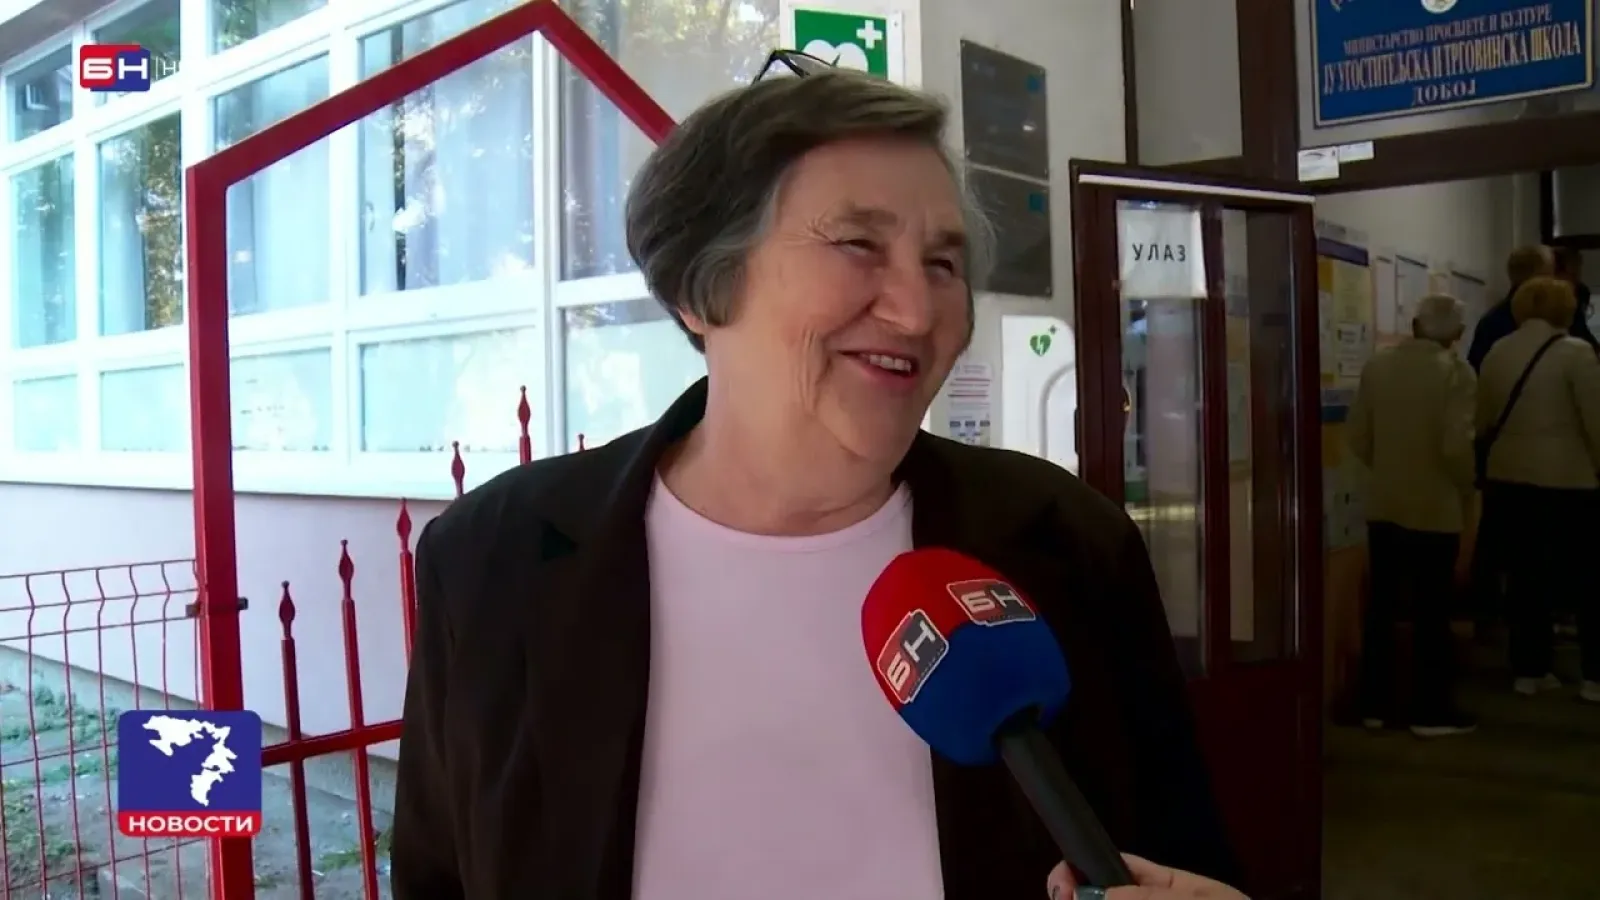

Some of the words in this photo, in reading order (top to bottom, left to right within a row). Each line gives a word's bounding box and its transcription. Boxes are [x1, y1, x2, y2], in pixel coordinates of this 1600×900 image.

[1490, 14, 1497, 32] И
[1500, 4, 1552, 29] КУЛТУРЕ
[1432, 45, 1442, 78] И
[1444, 32, 1528, 76] ТРГОВИНСКА
[1531, 22, 1581, 62] ШКОЛА
[1411, 79, 1477, 106] ДОБОЈ
[1132, 243, 1187, 263] УЛАЗ
